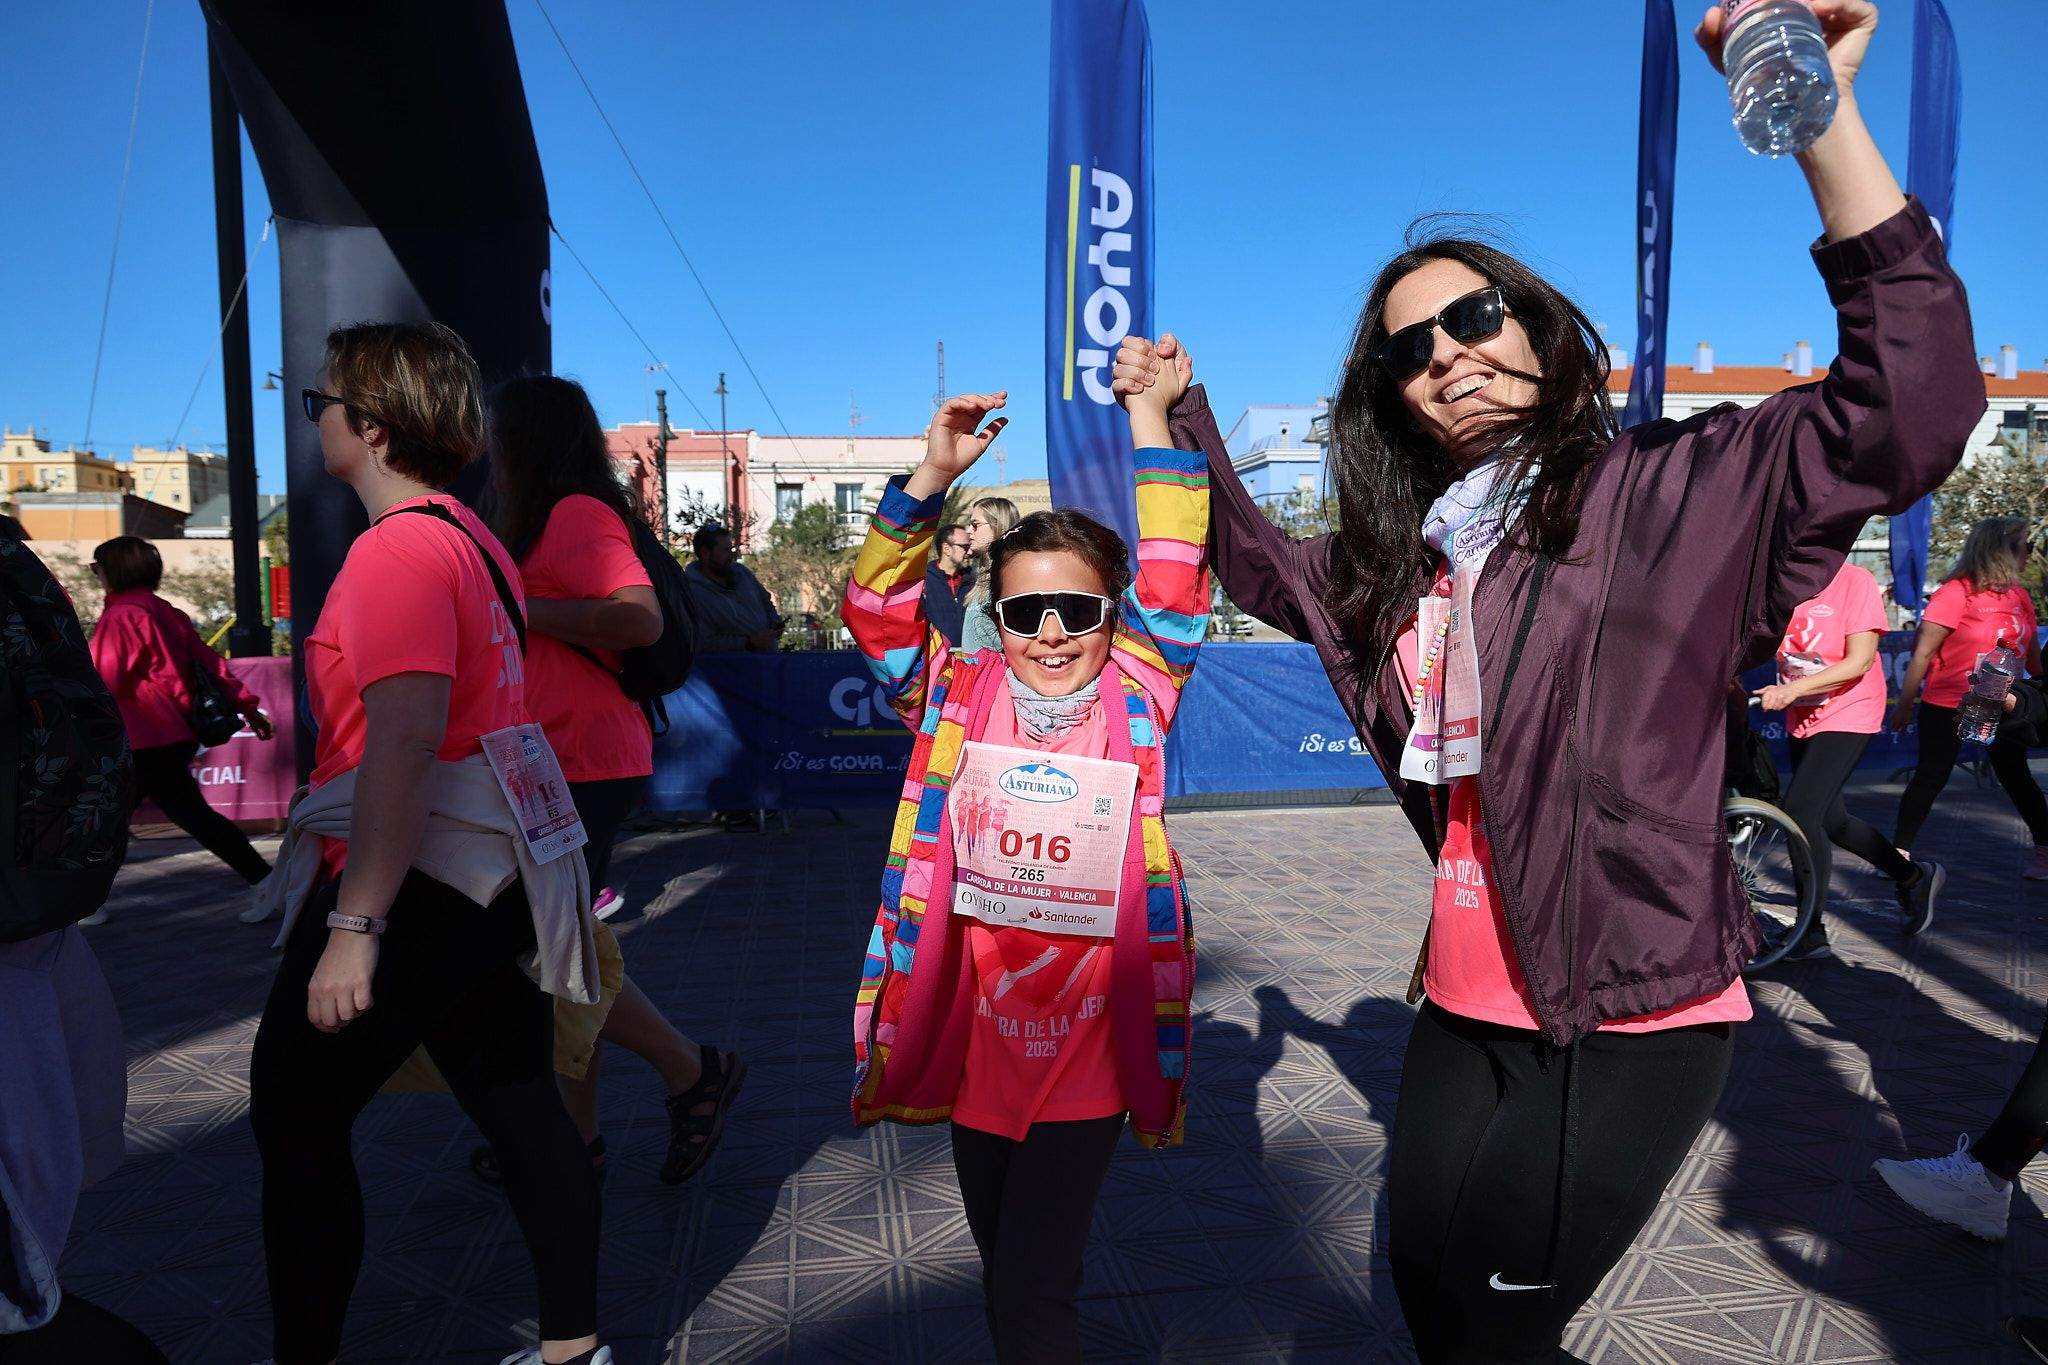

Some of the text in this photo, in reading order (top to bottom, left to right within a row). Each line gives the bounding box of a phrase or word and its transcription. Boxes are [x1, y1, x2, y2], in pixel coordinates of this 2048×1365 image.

[1327, 740, 1346, 752] es
[806, 758, 826, 770] es
[830, 755, 883, 771] GOYA
[1005, 774, 1072, 796] ASTURIANA
[1000, 829, 1072, 863] 016
[1010, 866, 1045, 882] 7265
[1456, 860, 1473, 885] DE
[966, 872, 1097, 902] CARRERA DE LA MUJER VALENCIA
[1454, 887, 1480, 909] 2025
[961, 891, 1006, 915] OYSHO
[1043, 911, 1098, 925] Santander
[1024, 1020, 1046, 1038] DE
[1049, 1014, 1070, 1036] LA
[1075, 994, 1106, 1020] JER
[1025, 1040, 1057, 1058] 2025
